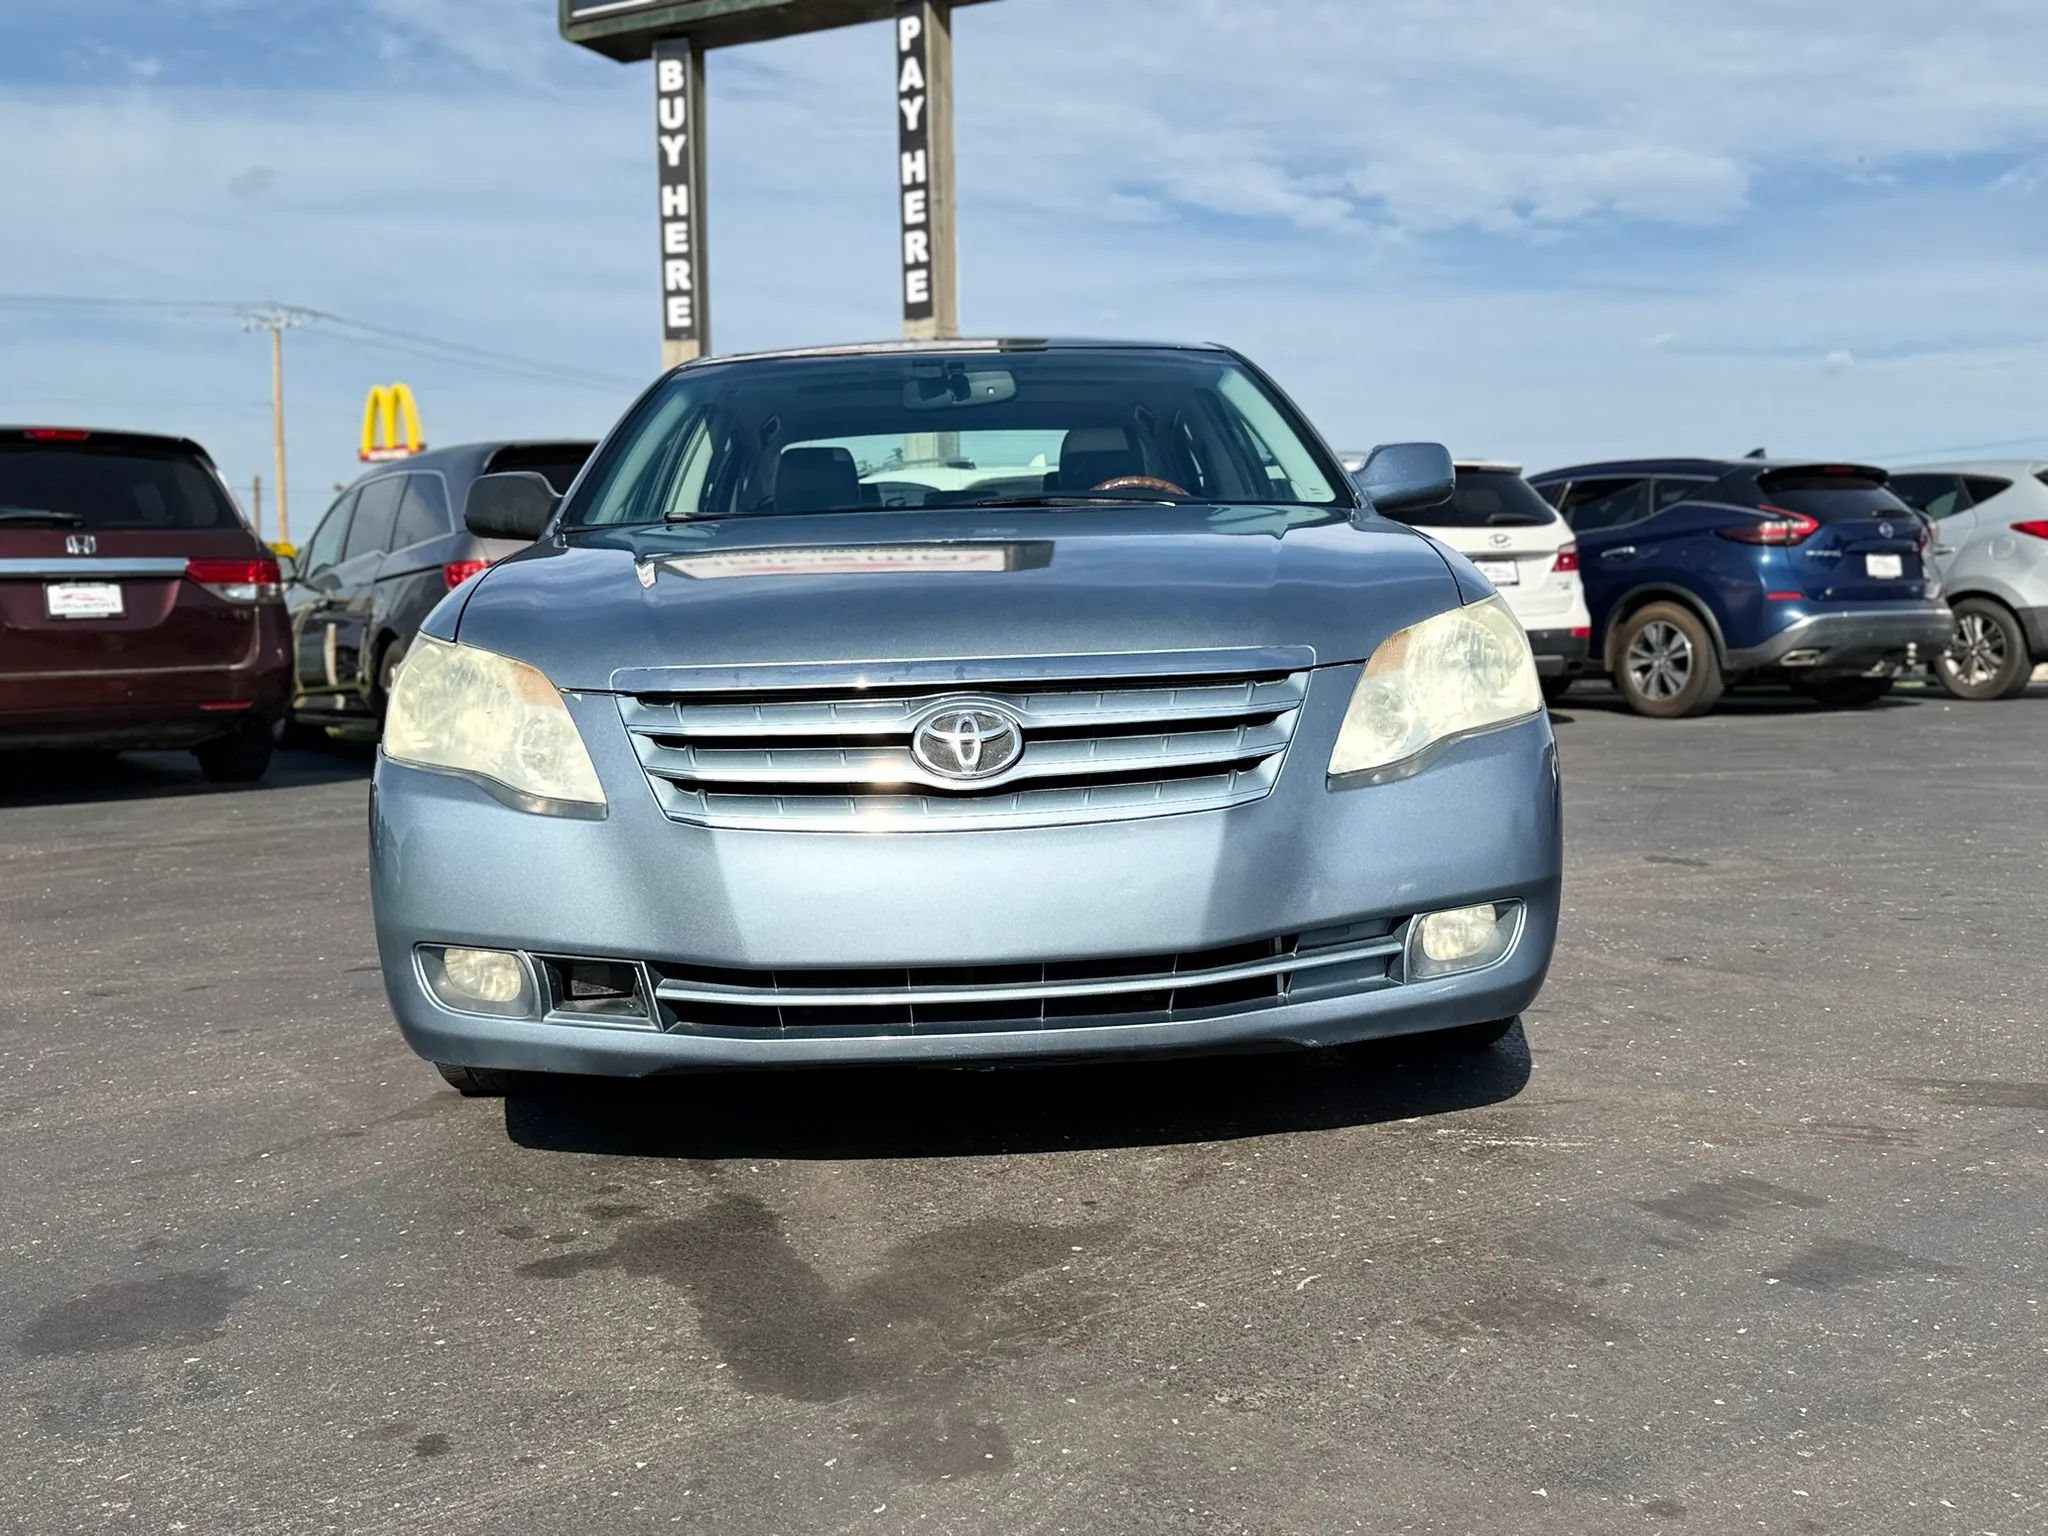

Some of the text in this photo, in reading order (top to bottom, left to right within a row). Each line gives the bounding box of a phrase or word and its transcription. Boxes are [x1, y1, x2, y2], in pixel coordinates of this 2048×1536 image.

[659, 60, 691, 327] BUY HERE
[899, 16, 929, 304] PAY HERE
